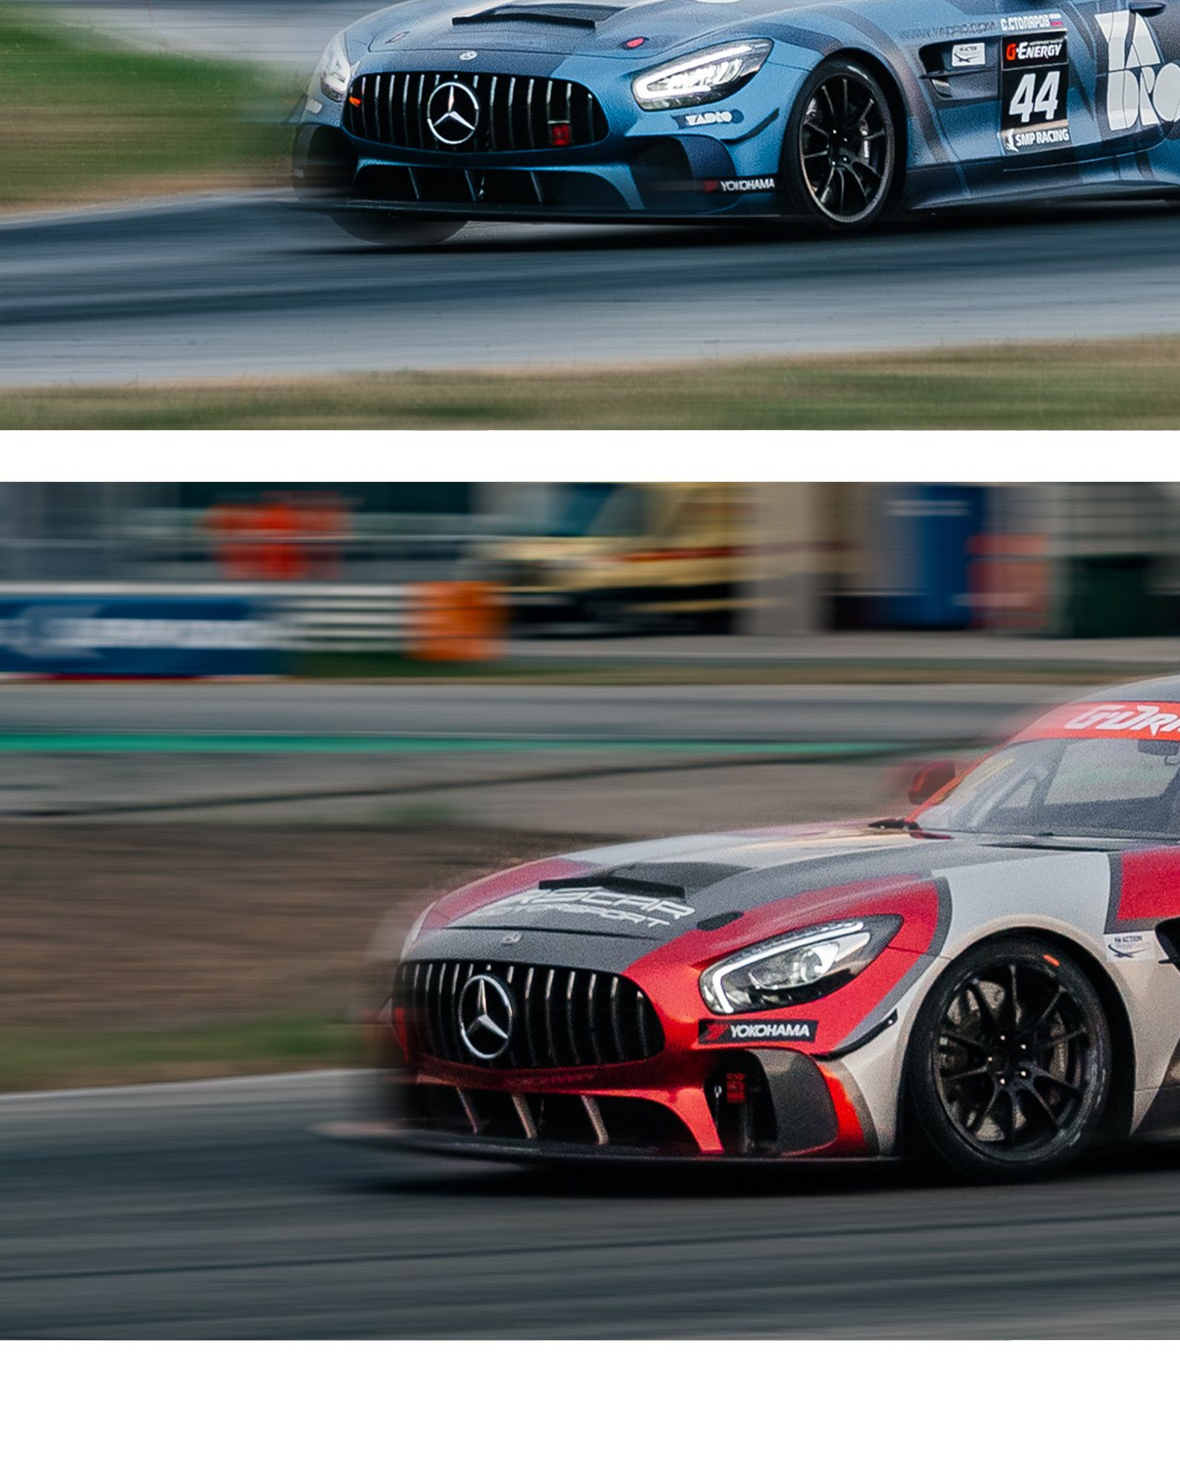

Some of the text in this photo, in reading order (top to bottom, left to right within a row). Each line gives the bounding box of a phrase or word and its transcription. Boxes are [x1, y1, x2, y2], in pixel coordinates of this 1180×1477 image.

[1009, 70, 1061, 123] 44
[1015, 128, 1070, 147] SMP RACING
[720, 178, 776, 192] YOKOHAMA
[730, 1023, 810, 1039] YOKOHAMA
